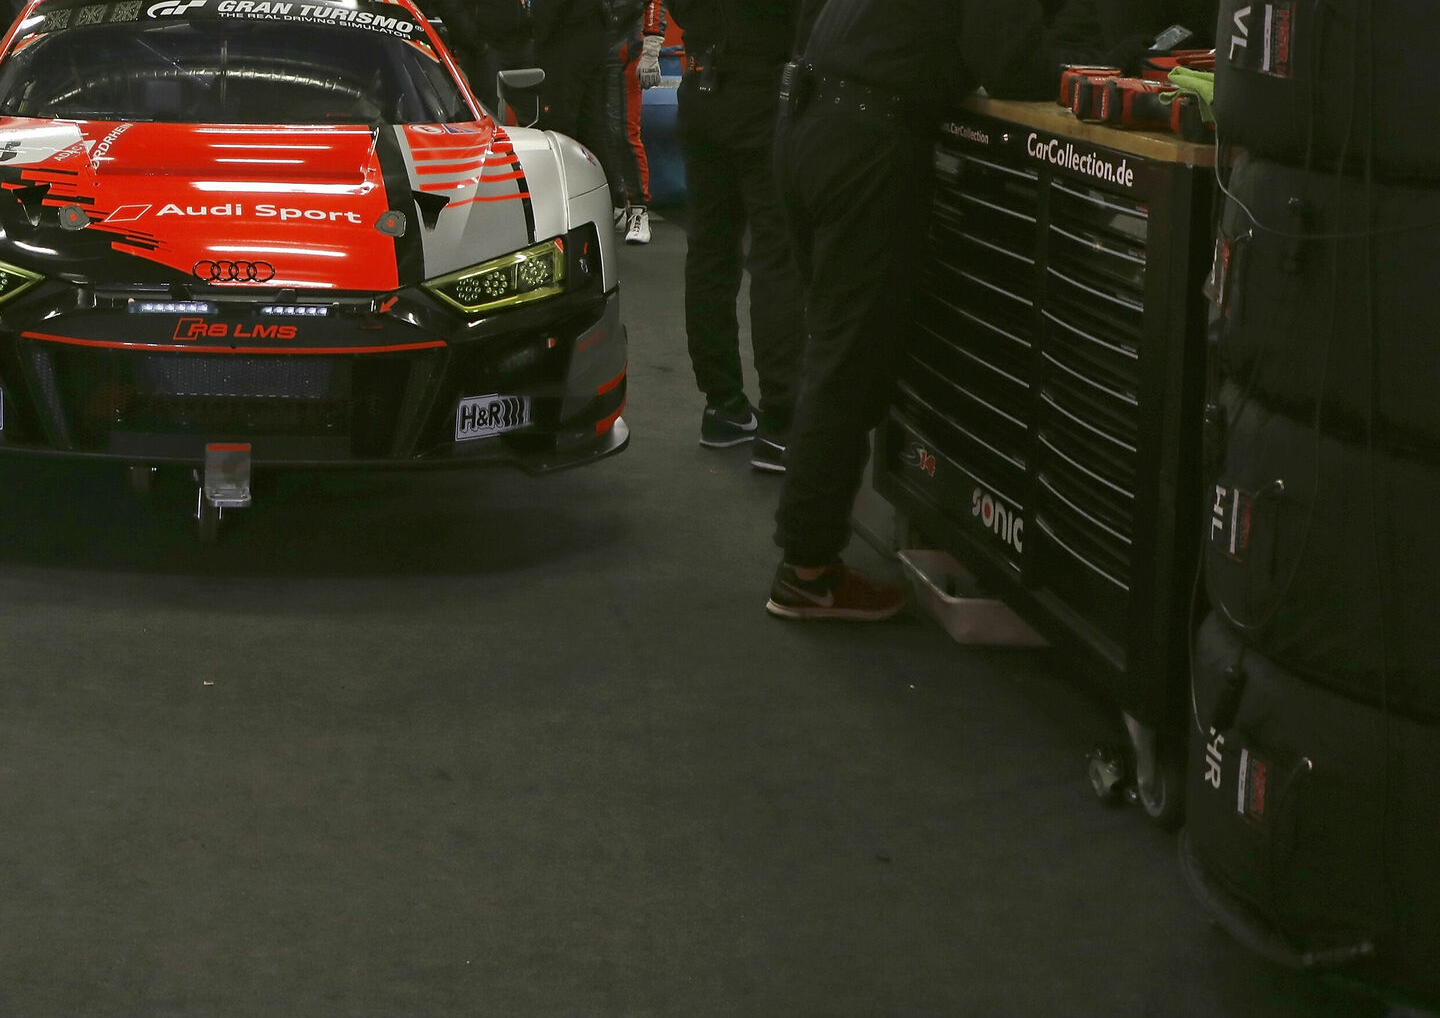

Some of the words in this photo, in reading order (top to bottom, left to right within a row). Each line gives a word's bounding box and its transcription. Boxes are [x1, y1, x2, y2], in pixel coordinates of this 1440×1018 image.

[217, 0, 293, 15] GRAN
[300, 4, 414, 33] TURISMO
[284, 15, 336, 25] DRIVING
[339, 21, 411, 39] SIMULATOR
[1229, 5, 1251, 61] VL
[1027, 132, 1134, 188] CarCollection.de
[156, 203, 242, 216] Audi
[255, 205, 362, 224] Sport
[186, 323, 228, 336] R8
[233, 323, 298, 339] LMS
[461, 402, 502, 431] H&R
[1204, 726, 1225, 790] HR
